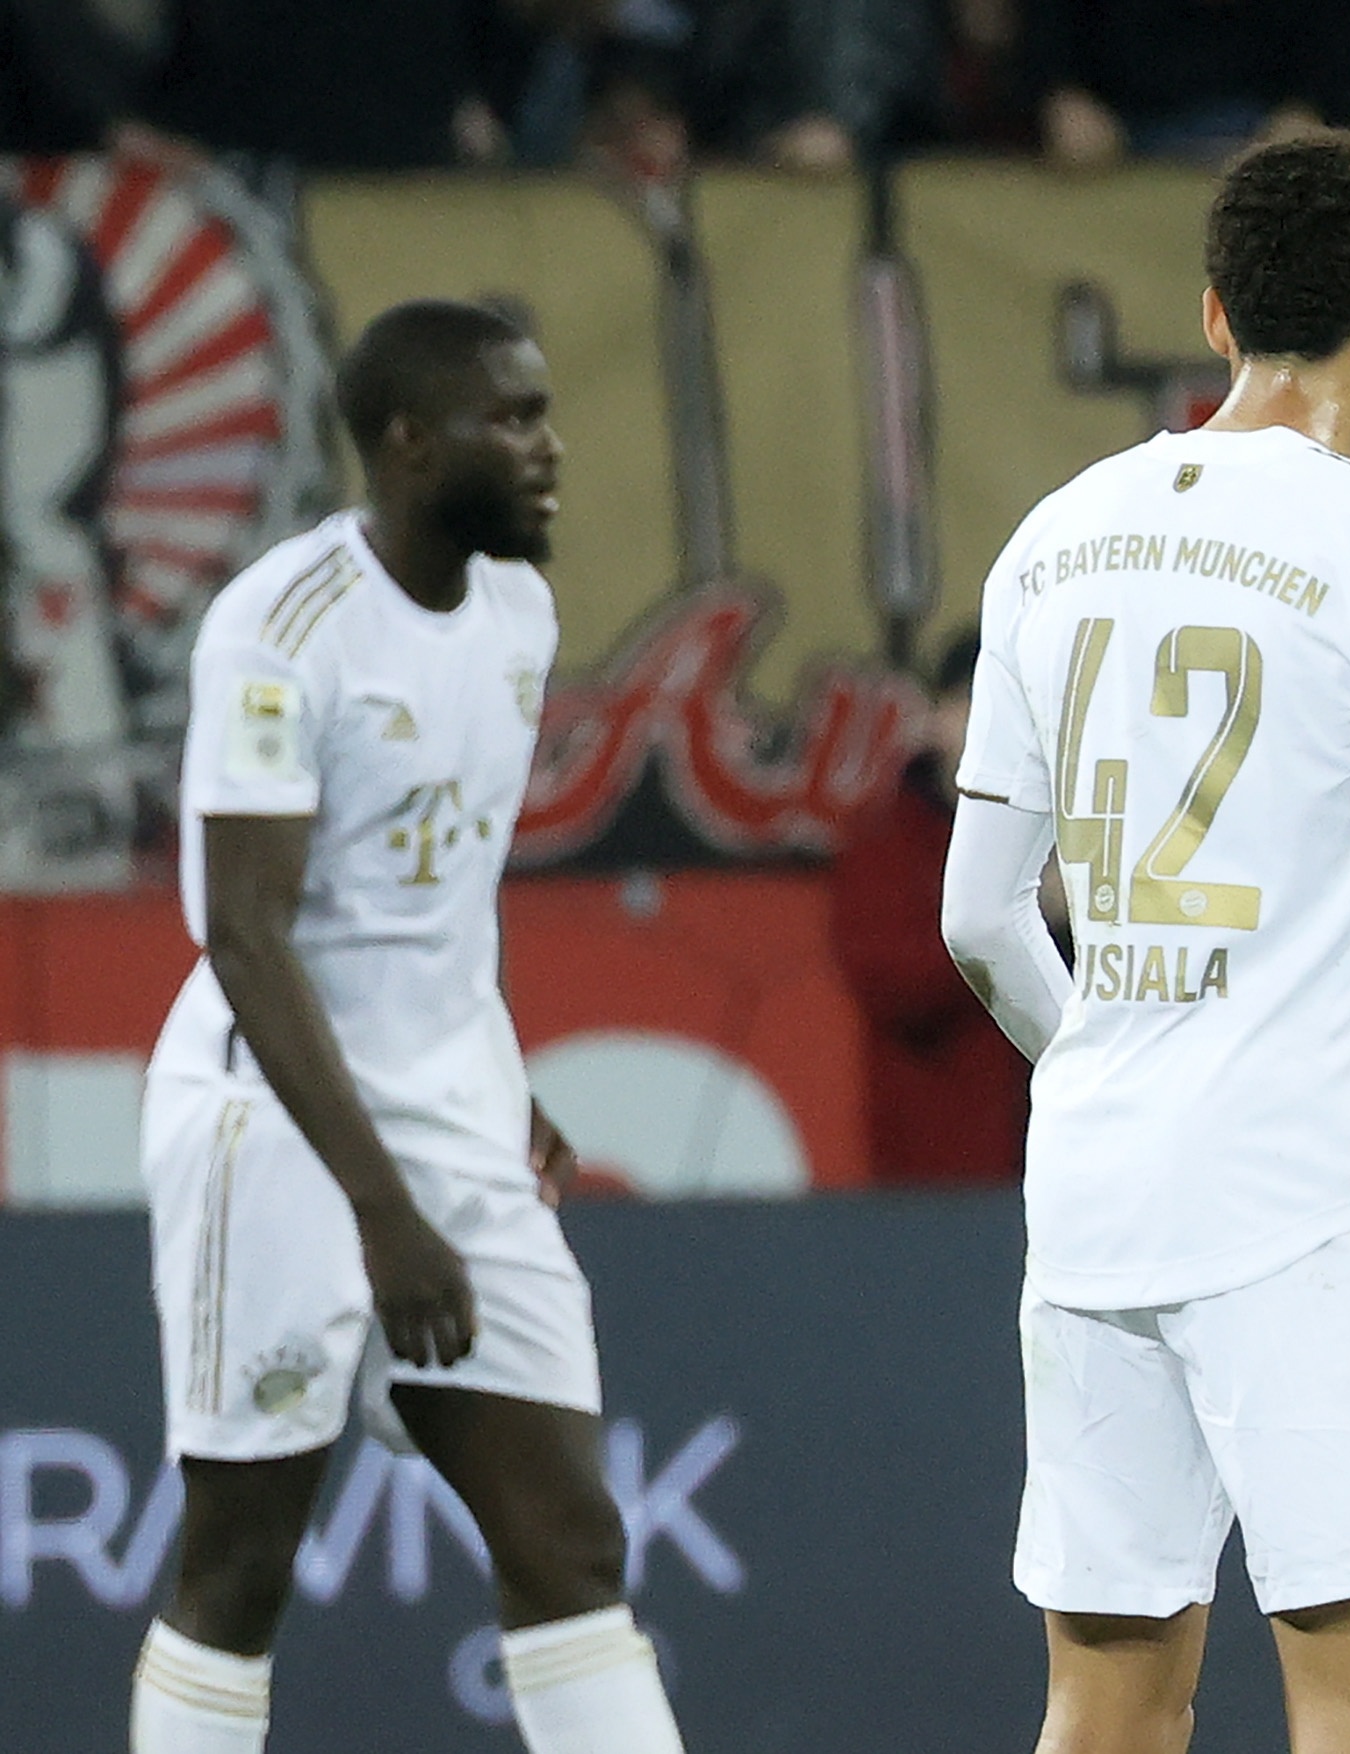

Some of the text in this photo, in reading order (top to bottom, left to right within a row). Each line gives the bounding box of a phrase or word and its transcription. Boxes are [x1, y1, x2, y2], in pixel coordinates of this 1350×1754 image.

[1018, 534, 1330, 618] FC BAYERN MÜNCHEN
[1055, 617, 1263, 931] 42
